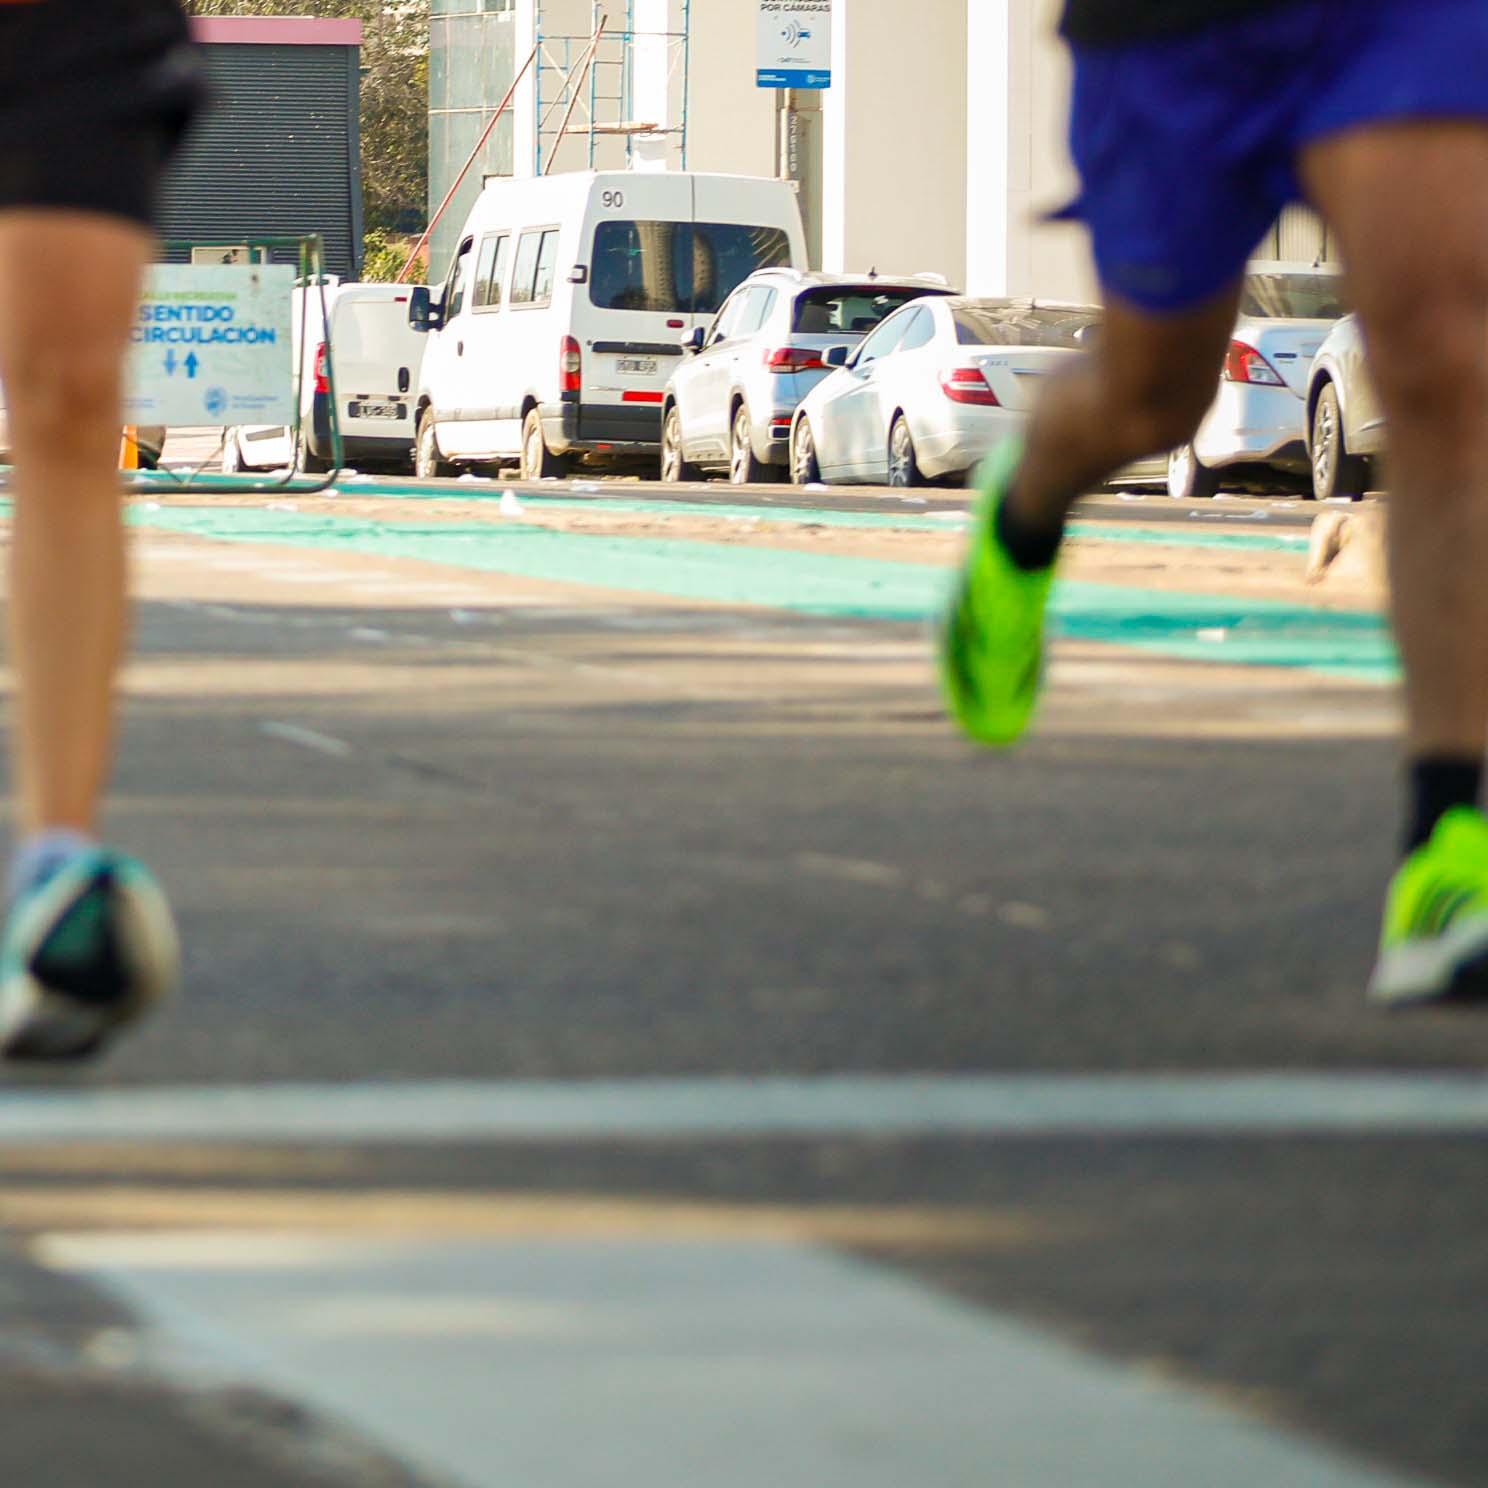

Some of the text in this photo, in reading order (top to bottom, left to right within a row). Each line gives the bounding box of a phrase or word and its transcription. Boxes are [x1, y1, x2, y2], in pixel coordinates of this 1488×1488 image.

[760, 3, 781, 11] POR
[602, 191, 624, 208] 90
[138, 305, 234, 322] SENTIDO
[128, 323, 276, 344] CIRCULACIÓN
